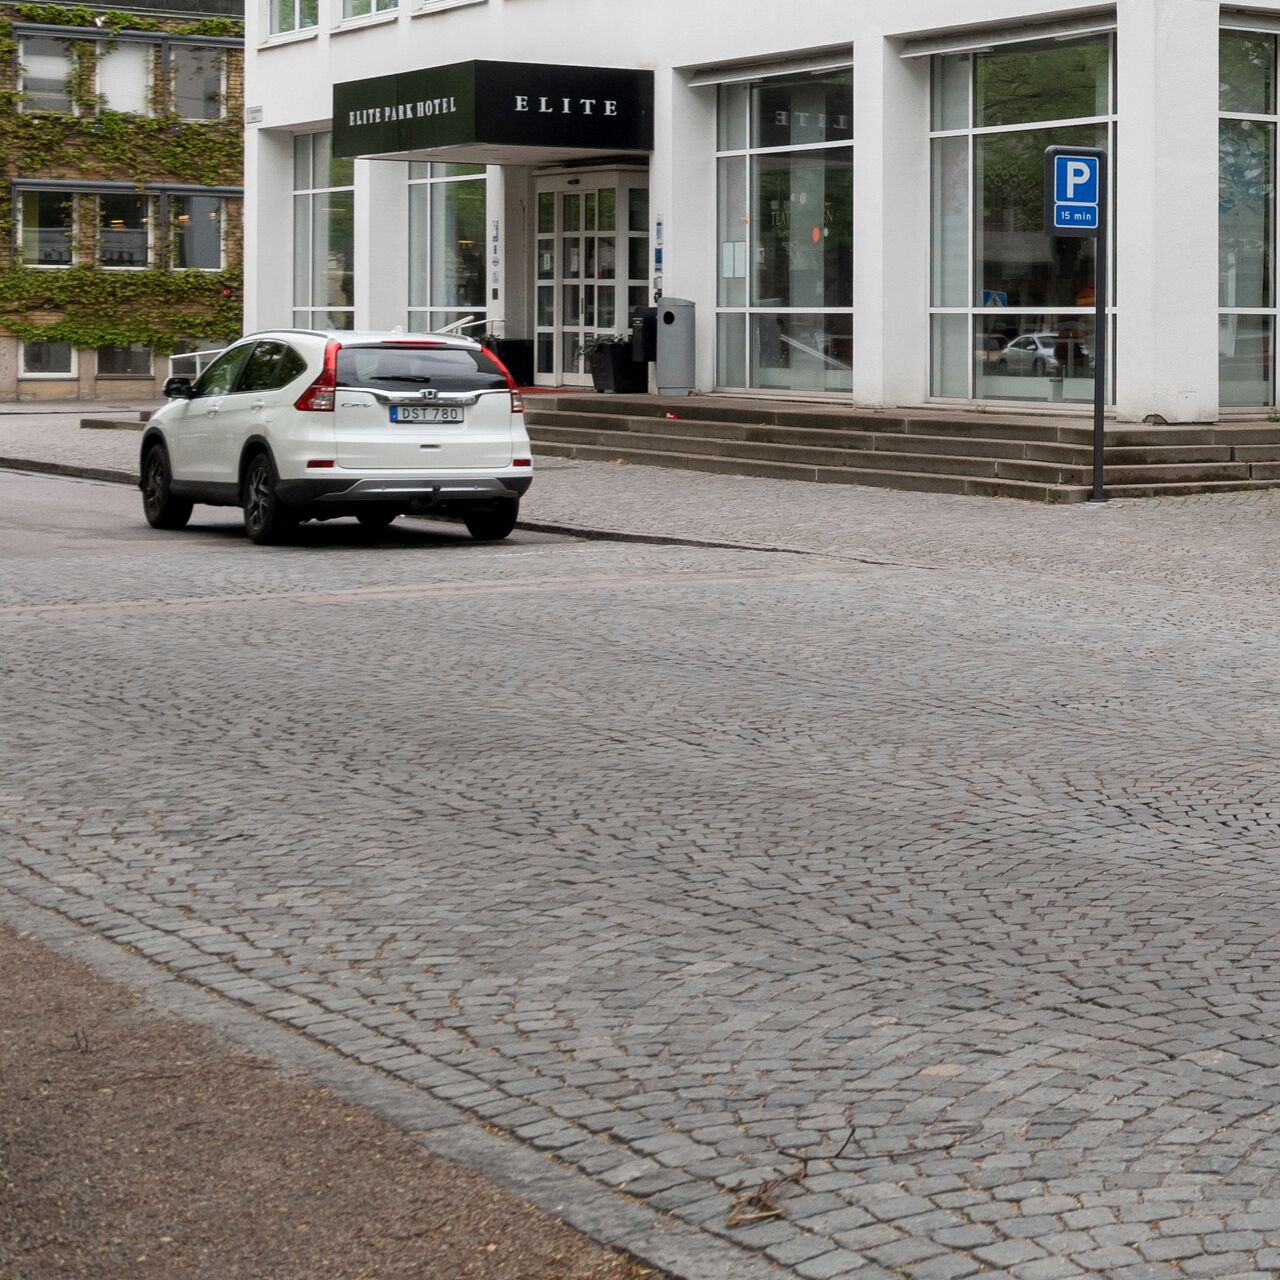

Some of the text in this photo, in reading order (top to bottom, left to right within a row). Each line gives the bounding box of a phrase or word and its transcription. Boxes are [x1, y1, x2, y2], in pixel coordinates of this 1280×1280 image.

[349, 96, 457, 126] ELITE PARK HOTEL
[514, 95, 618, 116] ELITE
[1066, 161, 1091, 198] P
[1061, 211, 1092, 221] 15 min
[402, 408, 458, 420] DST 780
